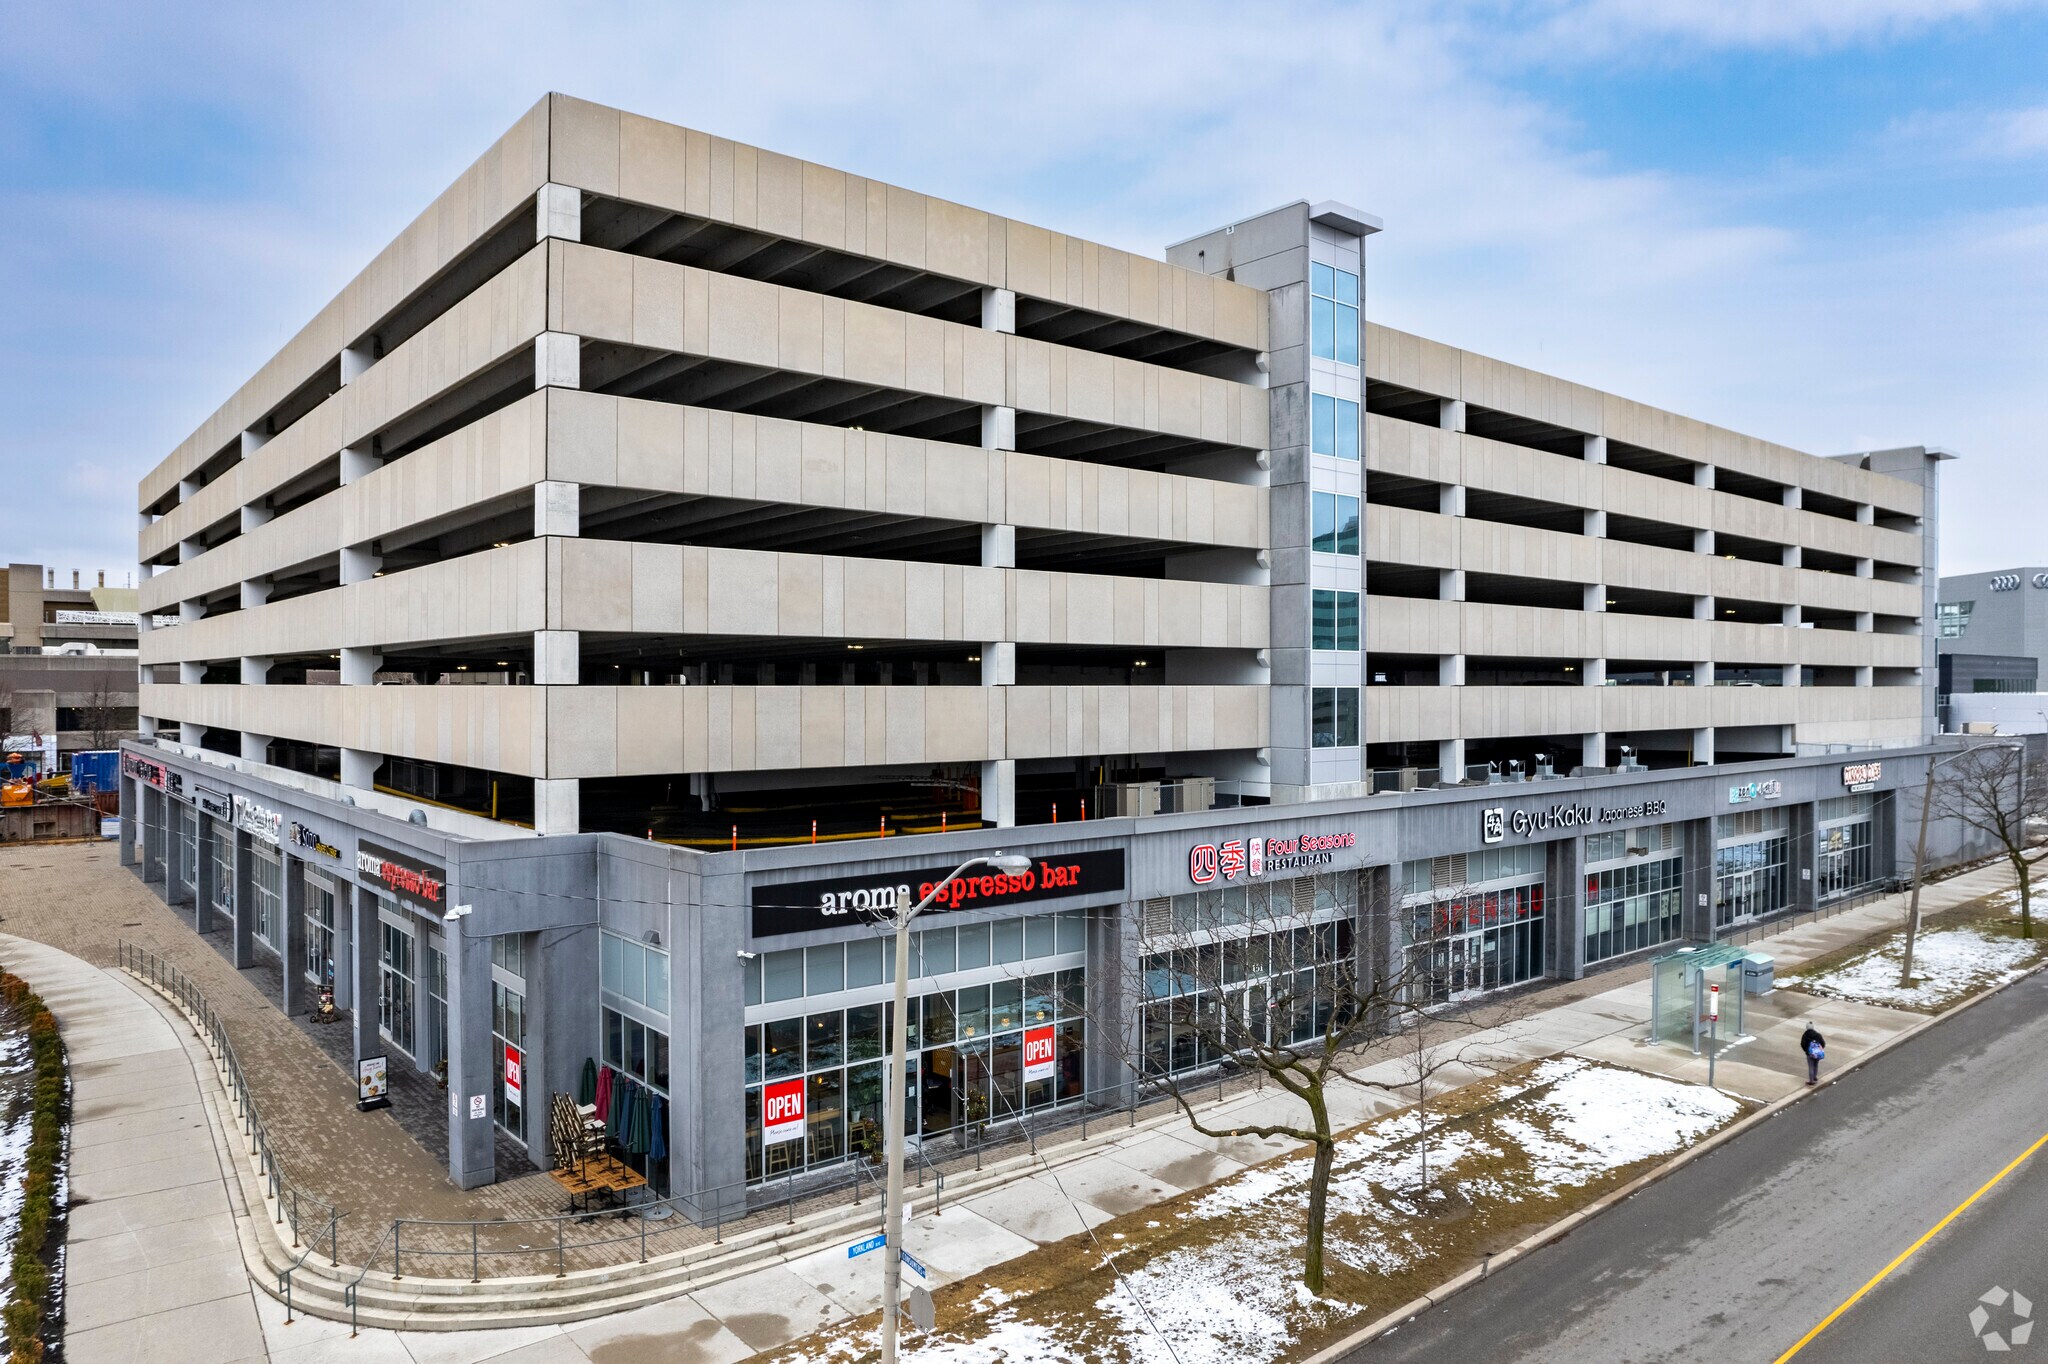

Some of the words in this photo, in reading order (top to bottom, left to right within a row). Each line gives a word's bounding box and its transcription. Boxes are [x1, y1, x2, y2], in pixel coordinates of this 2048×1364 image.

[1513, 804, 1594, 837] Gyu-Kaku
[1601, 805, 1644, 823] Japanese
[1646, 800, 1667, 816] BBQ
[1267, 838, 1298, 856] Four
[1300, 832, 1356, 852] Seasons
[357, 851, 381, 877] aroma
[1040, 861, 1081, 889] bar
[1190, 839, 1246, 885] 四季
[1268, 853, 1335, 871] RESTAURANT
[1027, 1038, 1052, 1061] OPEN
[767, 1092, 801, 1120] OPEN
